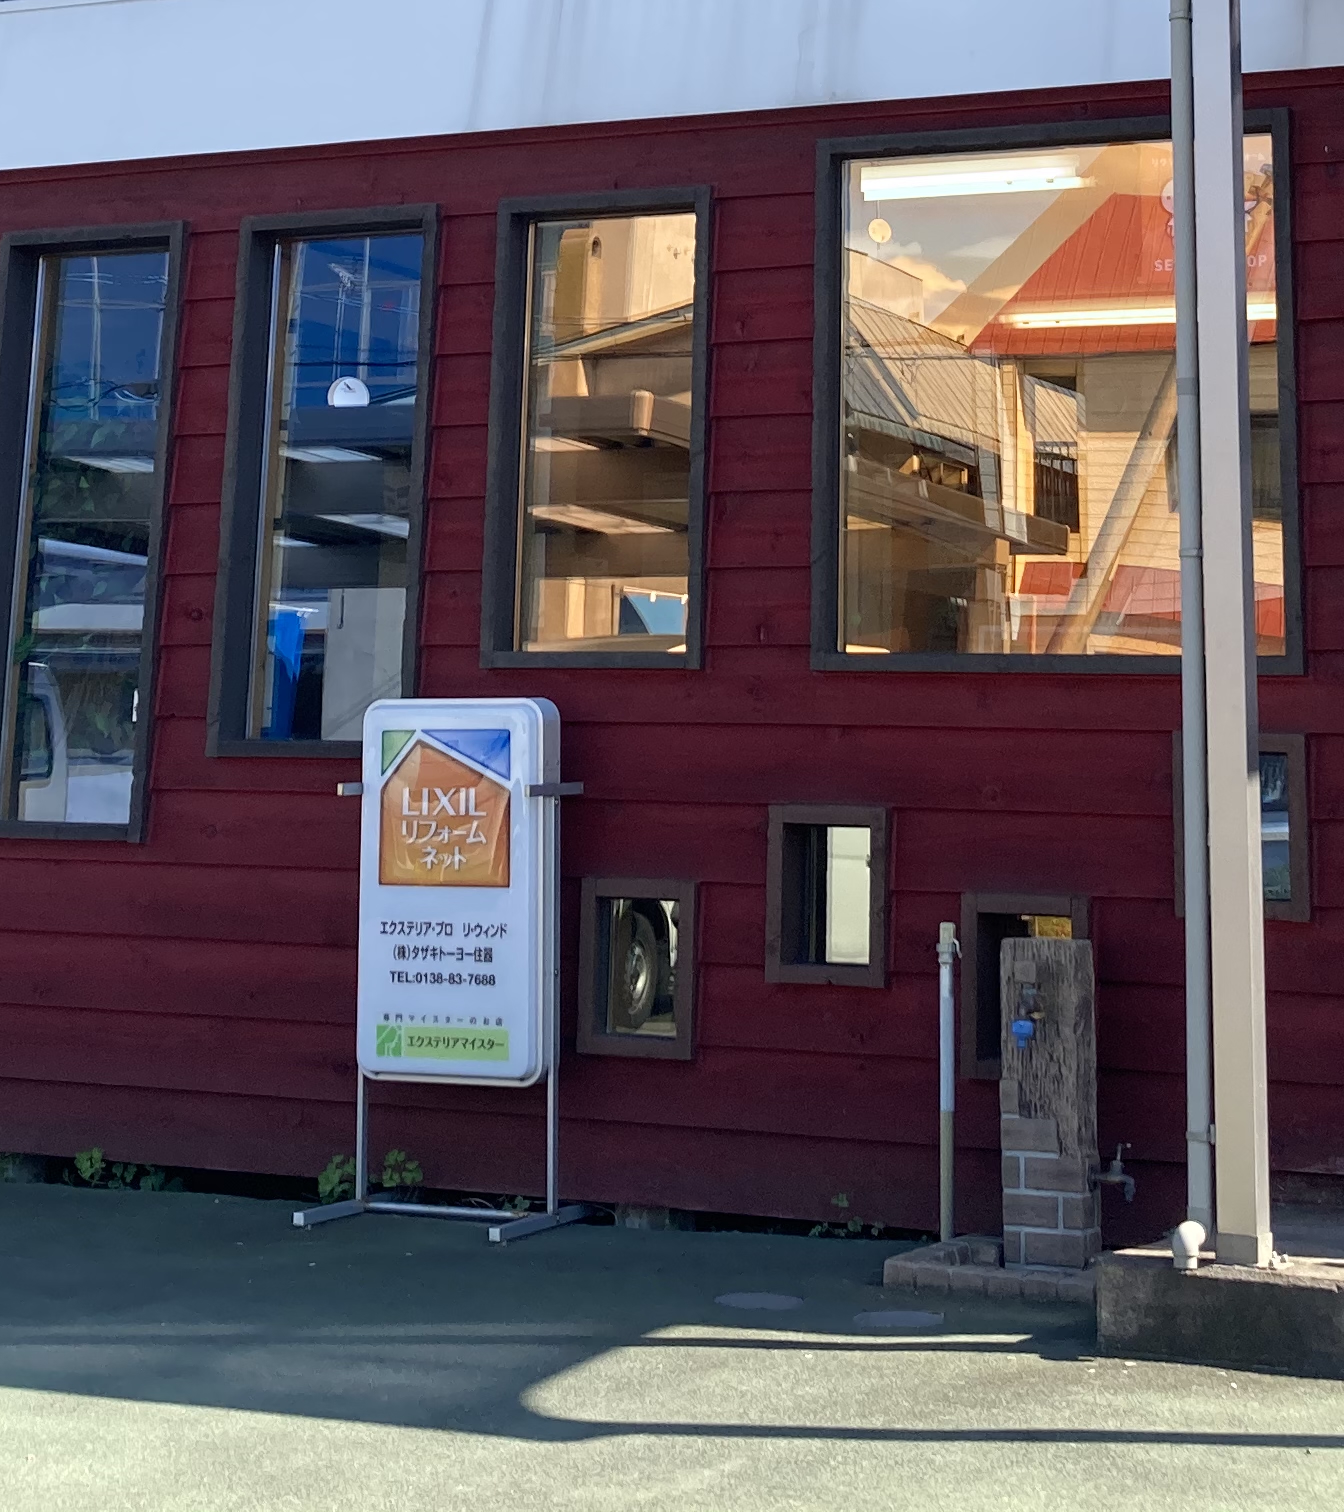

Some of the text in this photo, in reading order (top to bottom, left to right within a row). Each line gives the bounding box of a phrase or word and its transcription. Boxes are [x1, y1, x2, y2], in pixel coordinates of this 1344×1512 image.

[402, 787, 487, 816] LIXIL
[402, 819, 487, 844] リフォーム
[420, 846, 467, 870] ネット
[379, 920, 508, 939] エクステリア・プロ リ・ウィンド
[407, 1035, 505, 1050] エクステリアマイスター
